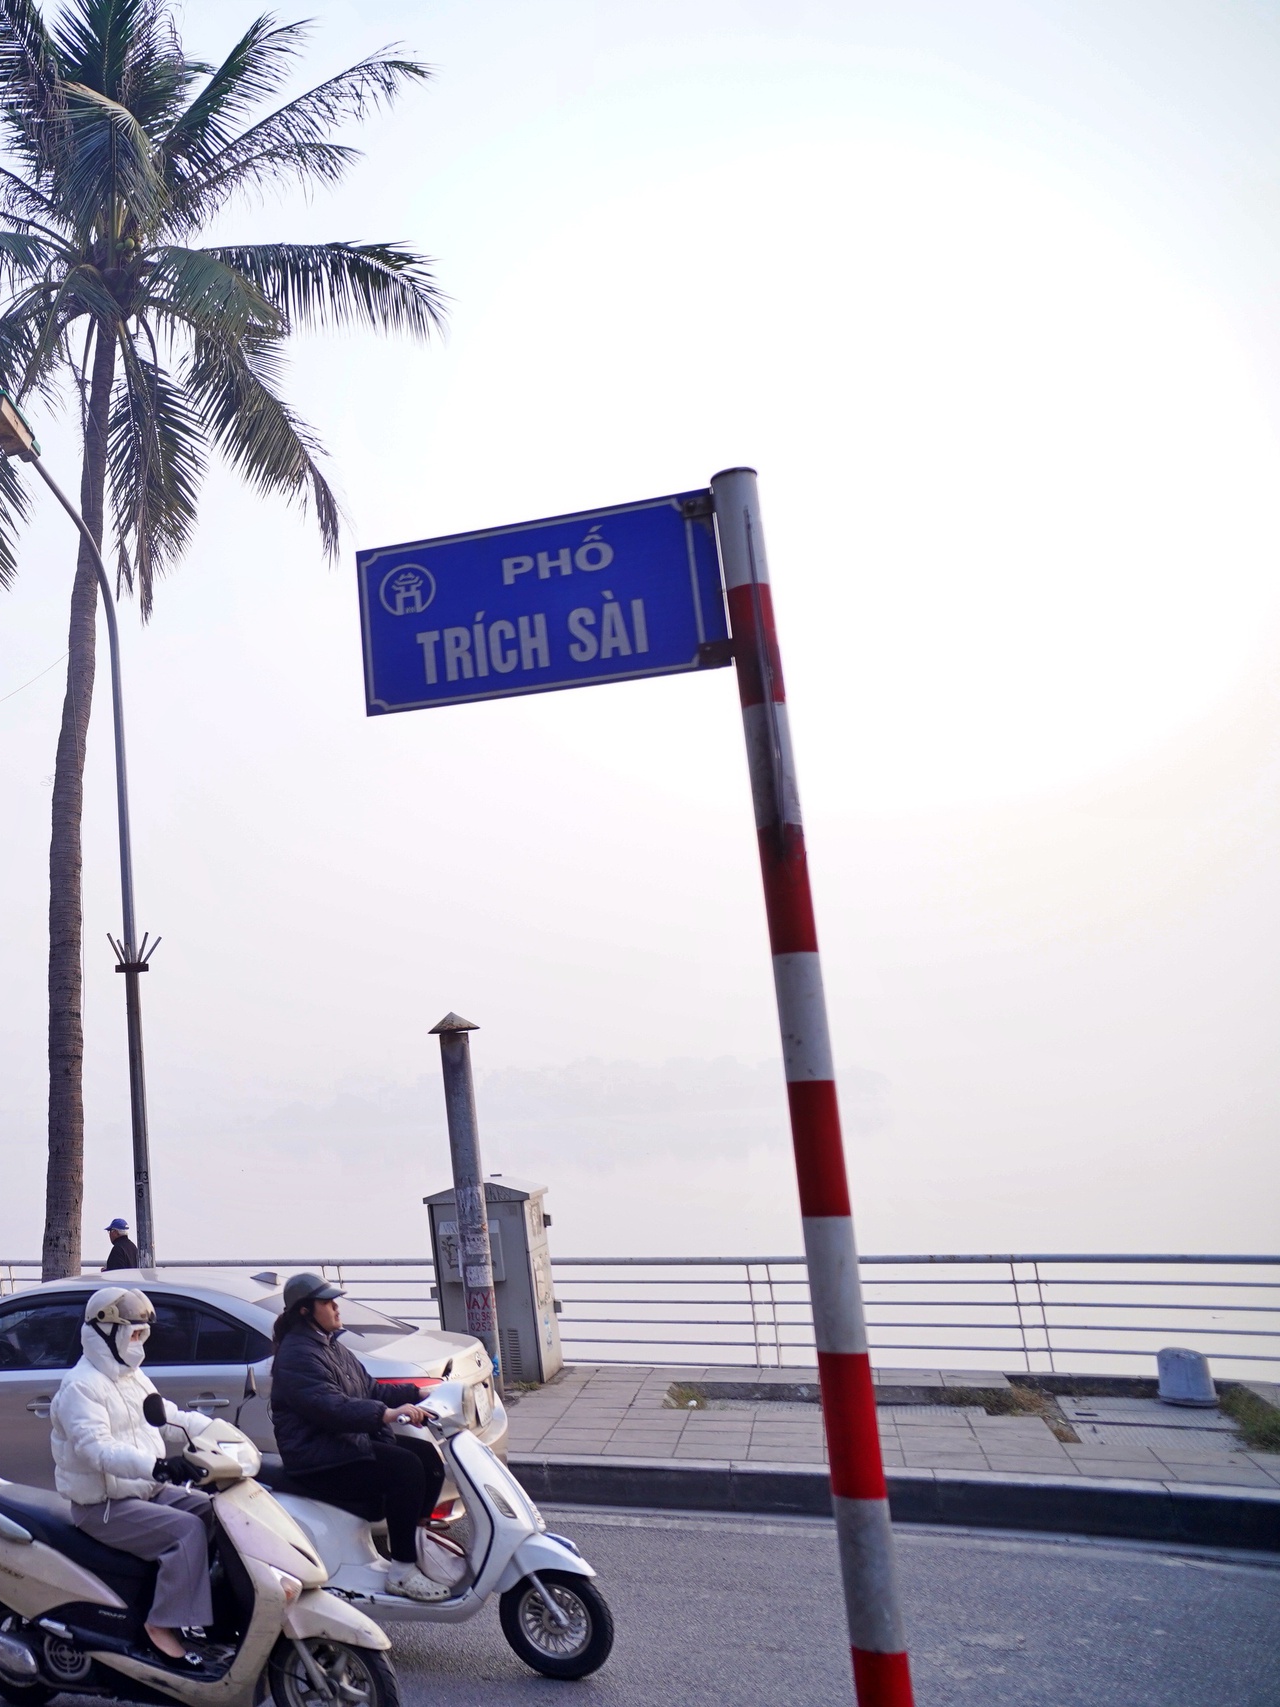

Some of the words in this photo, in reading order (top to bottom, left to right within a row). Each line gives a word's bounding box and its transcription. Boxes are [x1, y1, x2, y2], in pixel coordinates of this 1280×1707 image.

[501, 525, 614, 586] PHỐ
[416, 611, 550, 685] TRÍCH
[567, 590, 650, 663] SÀI
